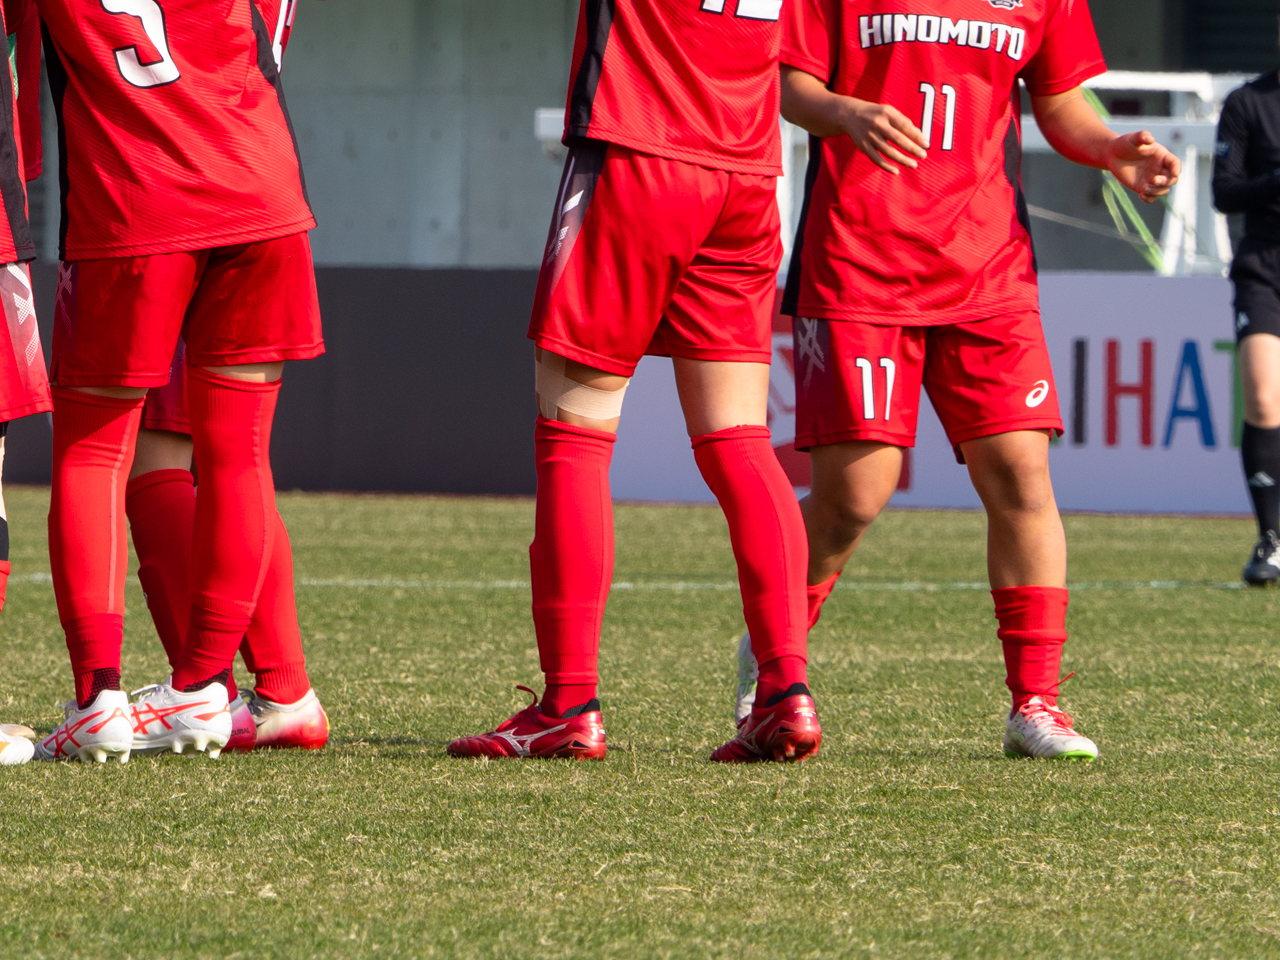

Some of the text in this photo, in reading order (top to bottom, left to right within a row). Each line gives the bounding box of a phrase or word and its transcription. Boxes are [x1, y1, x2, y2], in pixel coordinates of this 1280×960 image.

[858, 13, 1025, 61] HINOMOTO
[919, 81, 956, 151] 11
[855, 356, 895, 421] 11
[1051, 338, 1242, 448] IHAT
